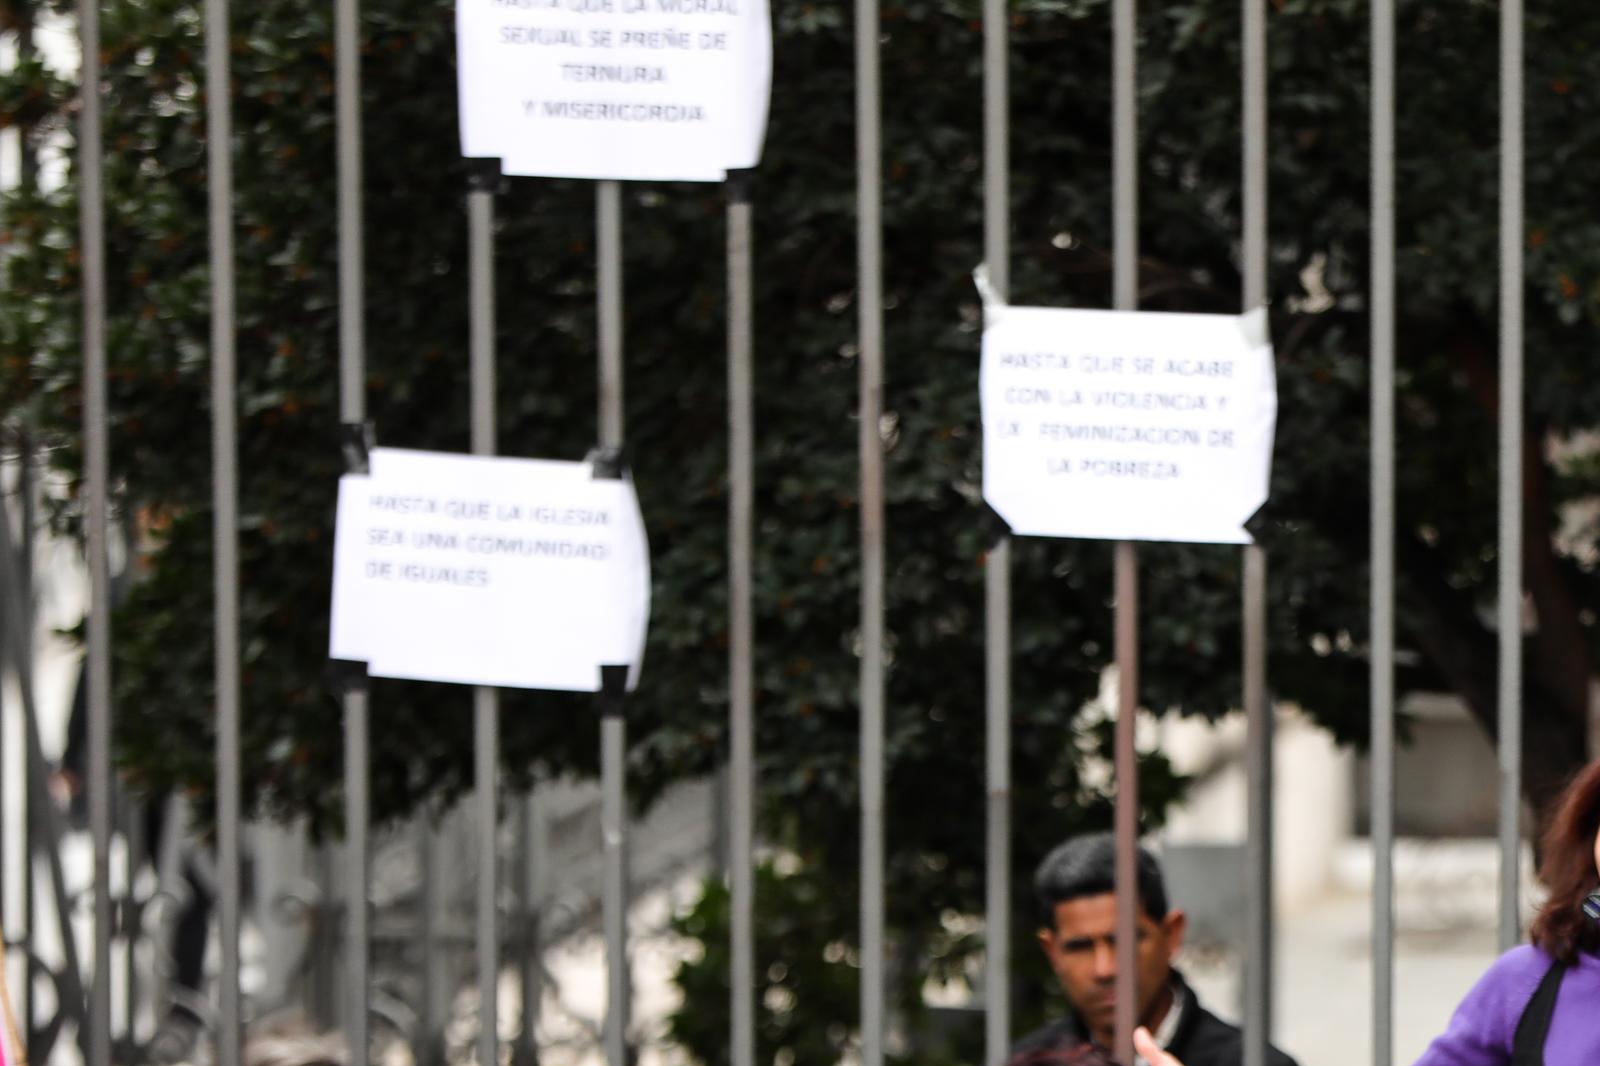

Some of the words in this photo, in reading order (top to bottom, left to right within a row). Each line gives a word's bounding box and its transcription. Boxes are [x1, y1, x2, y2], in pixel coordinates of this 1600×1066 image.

[588, 29, 613, 48] SE
[699, 32, 728, 50] DE
[559, 62, 667, 83] TERNURA
[522, 99, 535, 118] Y
[542, 100, 706, 122] MISERICORDIA
[999, 352, 1070, 370] HASTA
[1079, 354, 1124, 374] QUE
[1133, 357, 1155, 375] SE
[1164, 358, 1234, 378] ACABE
[1005, 386, 1052, 405] CON
[1058, 389, 1084, 407] LA
[1093, 391, 1208, 411] VIOLENCIA
[1216, 394, 1230, 411] Y
[997, 419, 1021, 438] LA
[1207, 428, 1236, 448] DE
[1047, 457, 1071, 475] LA
[1080, 458, 1180, 480] POBREZA
[369, 495, 437, 514] HASTA
[444, 499, 490, 521] QUE
[496, 503, 521, 522] LA
[529, 506, 611, 526] IGLESIA
[367, 527, 404, 546] SEA
[412, 531, 458, 550] UNA
[466, 534, 610, 560] COMUNIDAD
[365, 561, 392, 580] DE
[399, 562, 488, 587] IGUALES
